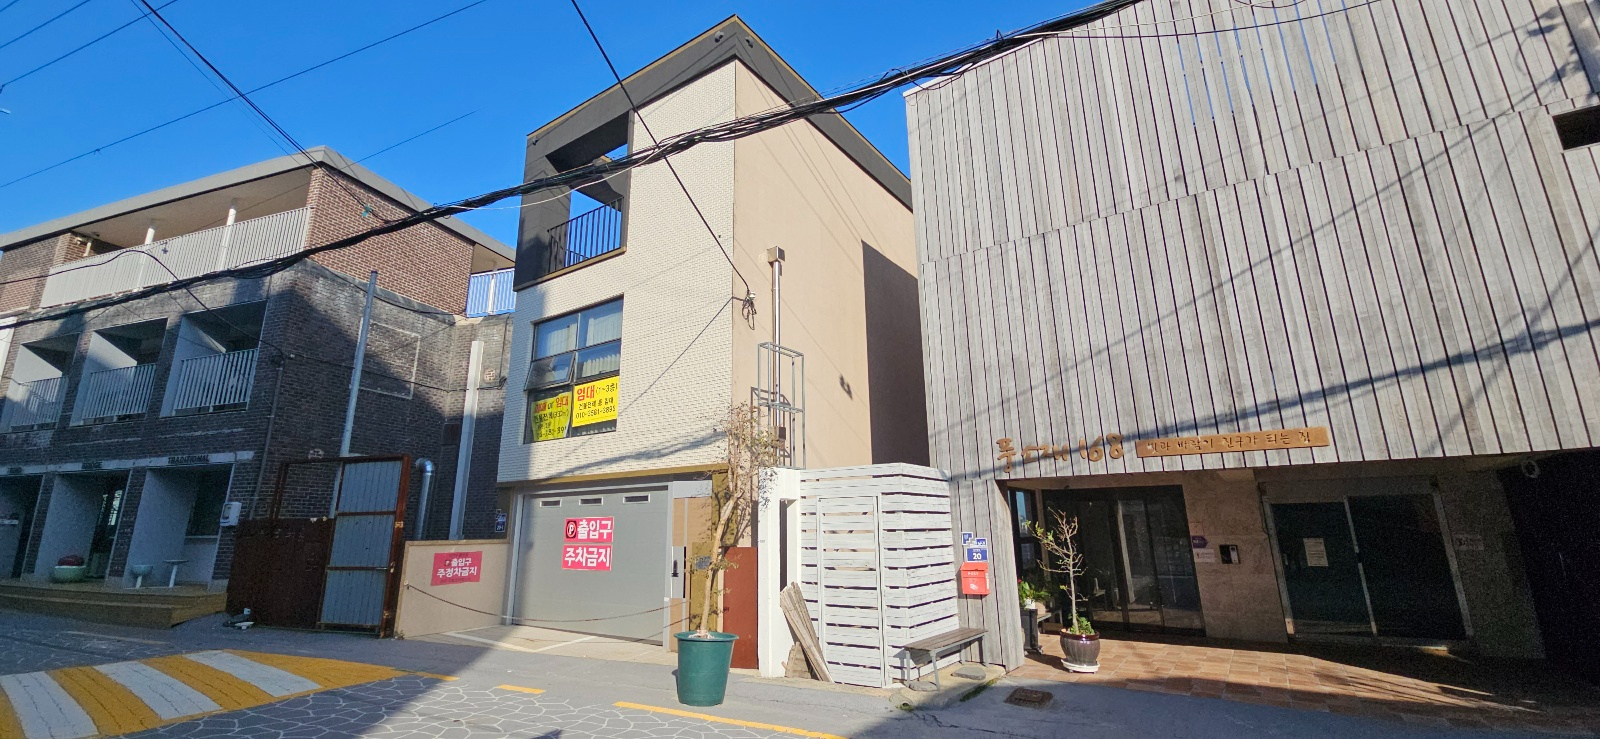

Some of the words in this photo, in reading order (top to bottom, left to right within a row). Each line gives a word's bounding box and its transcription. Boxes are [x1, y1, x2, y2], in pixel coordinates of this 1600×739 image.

[577, 385, 595, 401] 임대
[556, 396, 569, 407] 임대
[1079, 433, 1124, 462] 168
[1177, 437, 1214, 451] 바람이
[1222, 435, 1258, 448] 친구가
[1266, 432, 1290, 444] 되는
[168, 454, 210, 464] TRADITIONAL
[577, 519, 612, 539] 출입구
[451, 558, 472, 567] 출입구
[565, 547, 610, 567] 주차금지
[437, 566, 477, 578] 주정차금지
